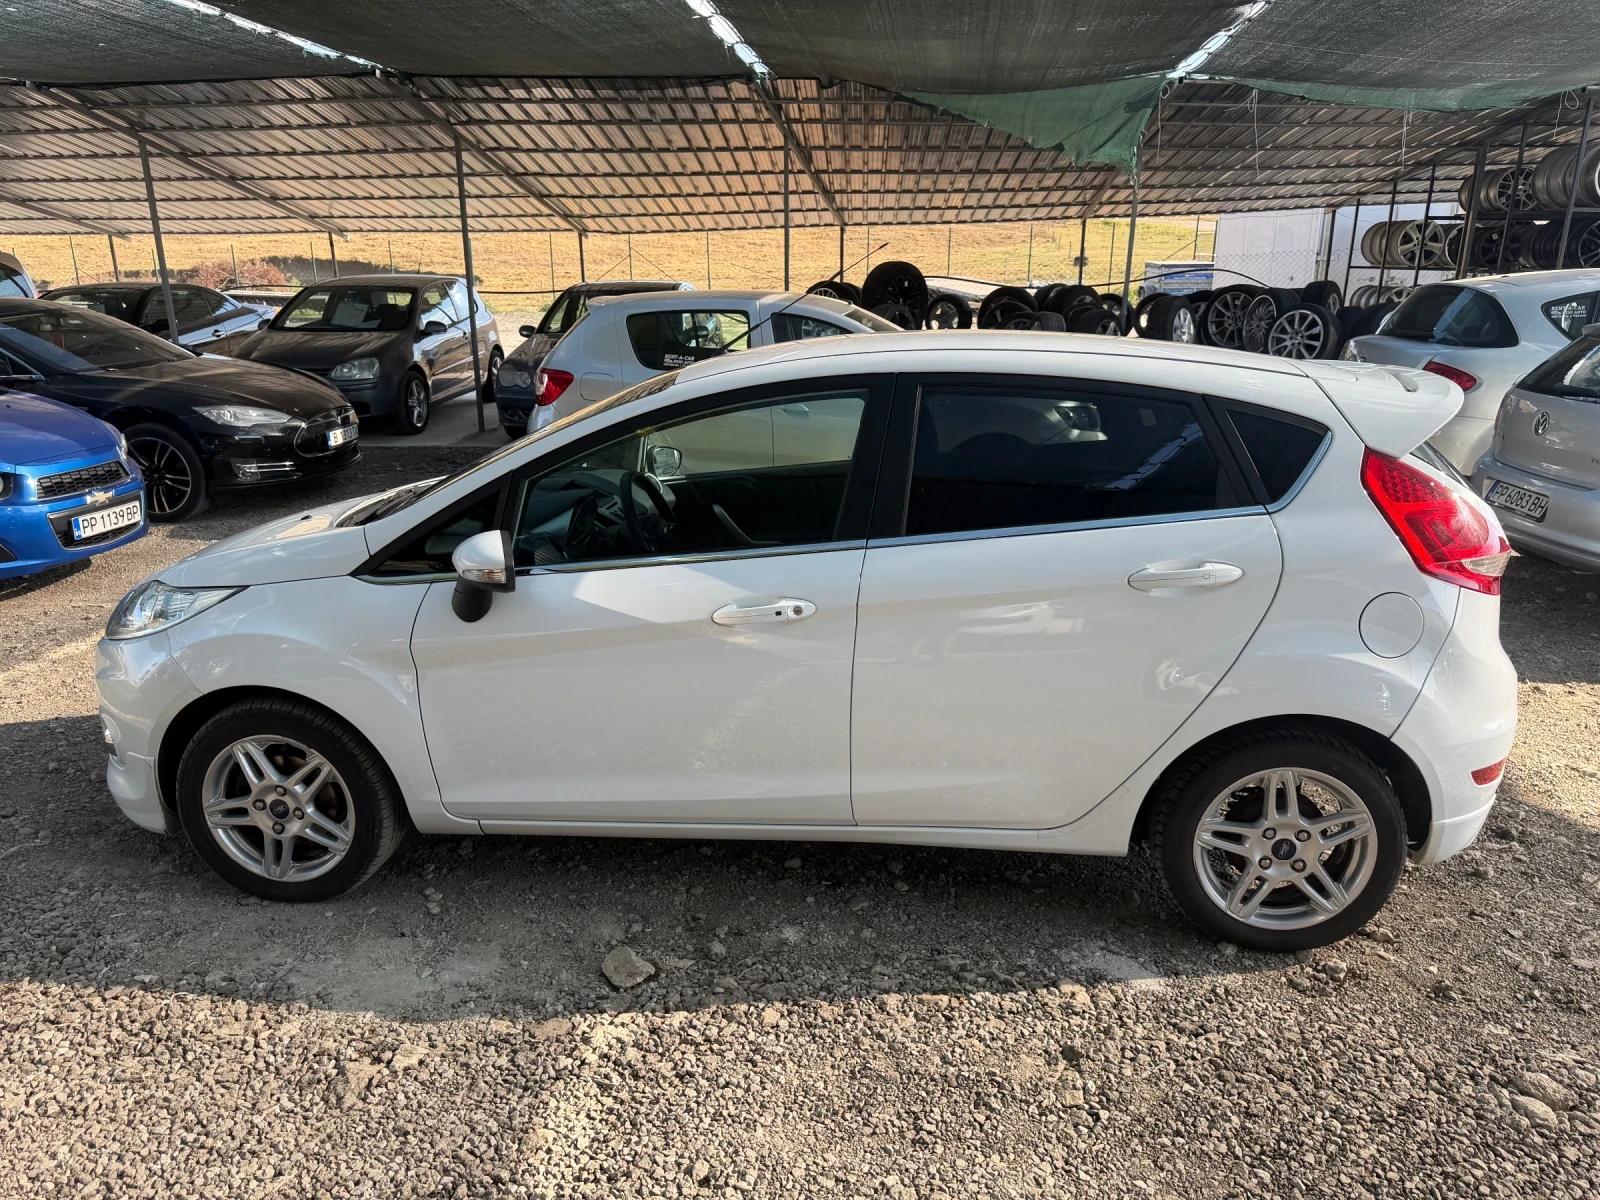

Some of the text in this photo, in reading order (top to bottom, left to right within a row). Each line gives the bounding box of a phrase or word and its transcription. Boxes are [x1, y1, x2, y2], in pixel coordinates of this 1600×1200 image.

[332, 432, 339, 444] B
[1491, 484, 1549, 516] PP 6083 BH
[81, 516, 98, 535] PP
[100, 509, 125, 529] 1139
[126, 505, 139, 522] BP
